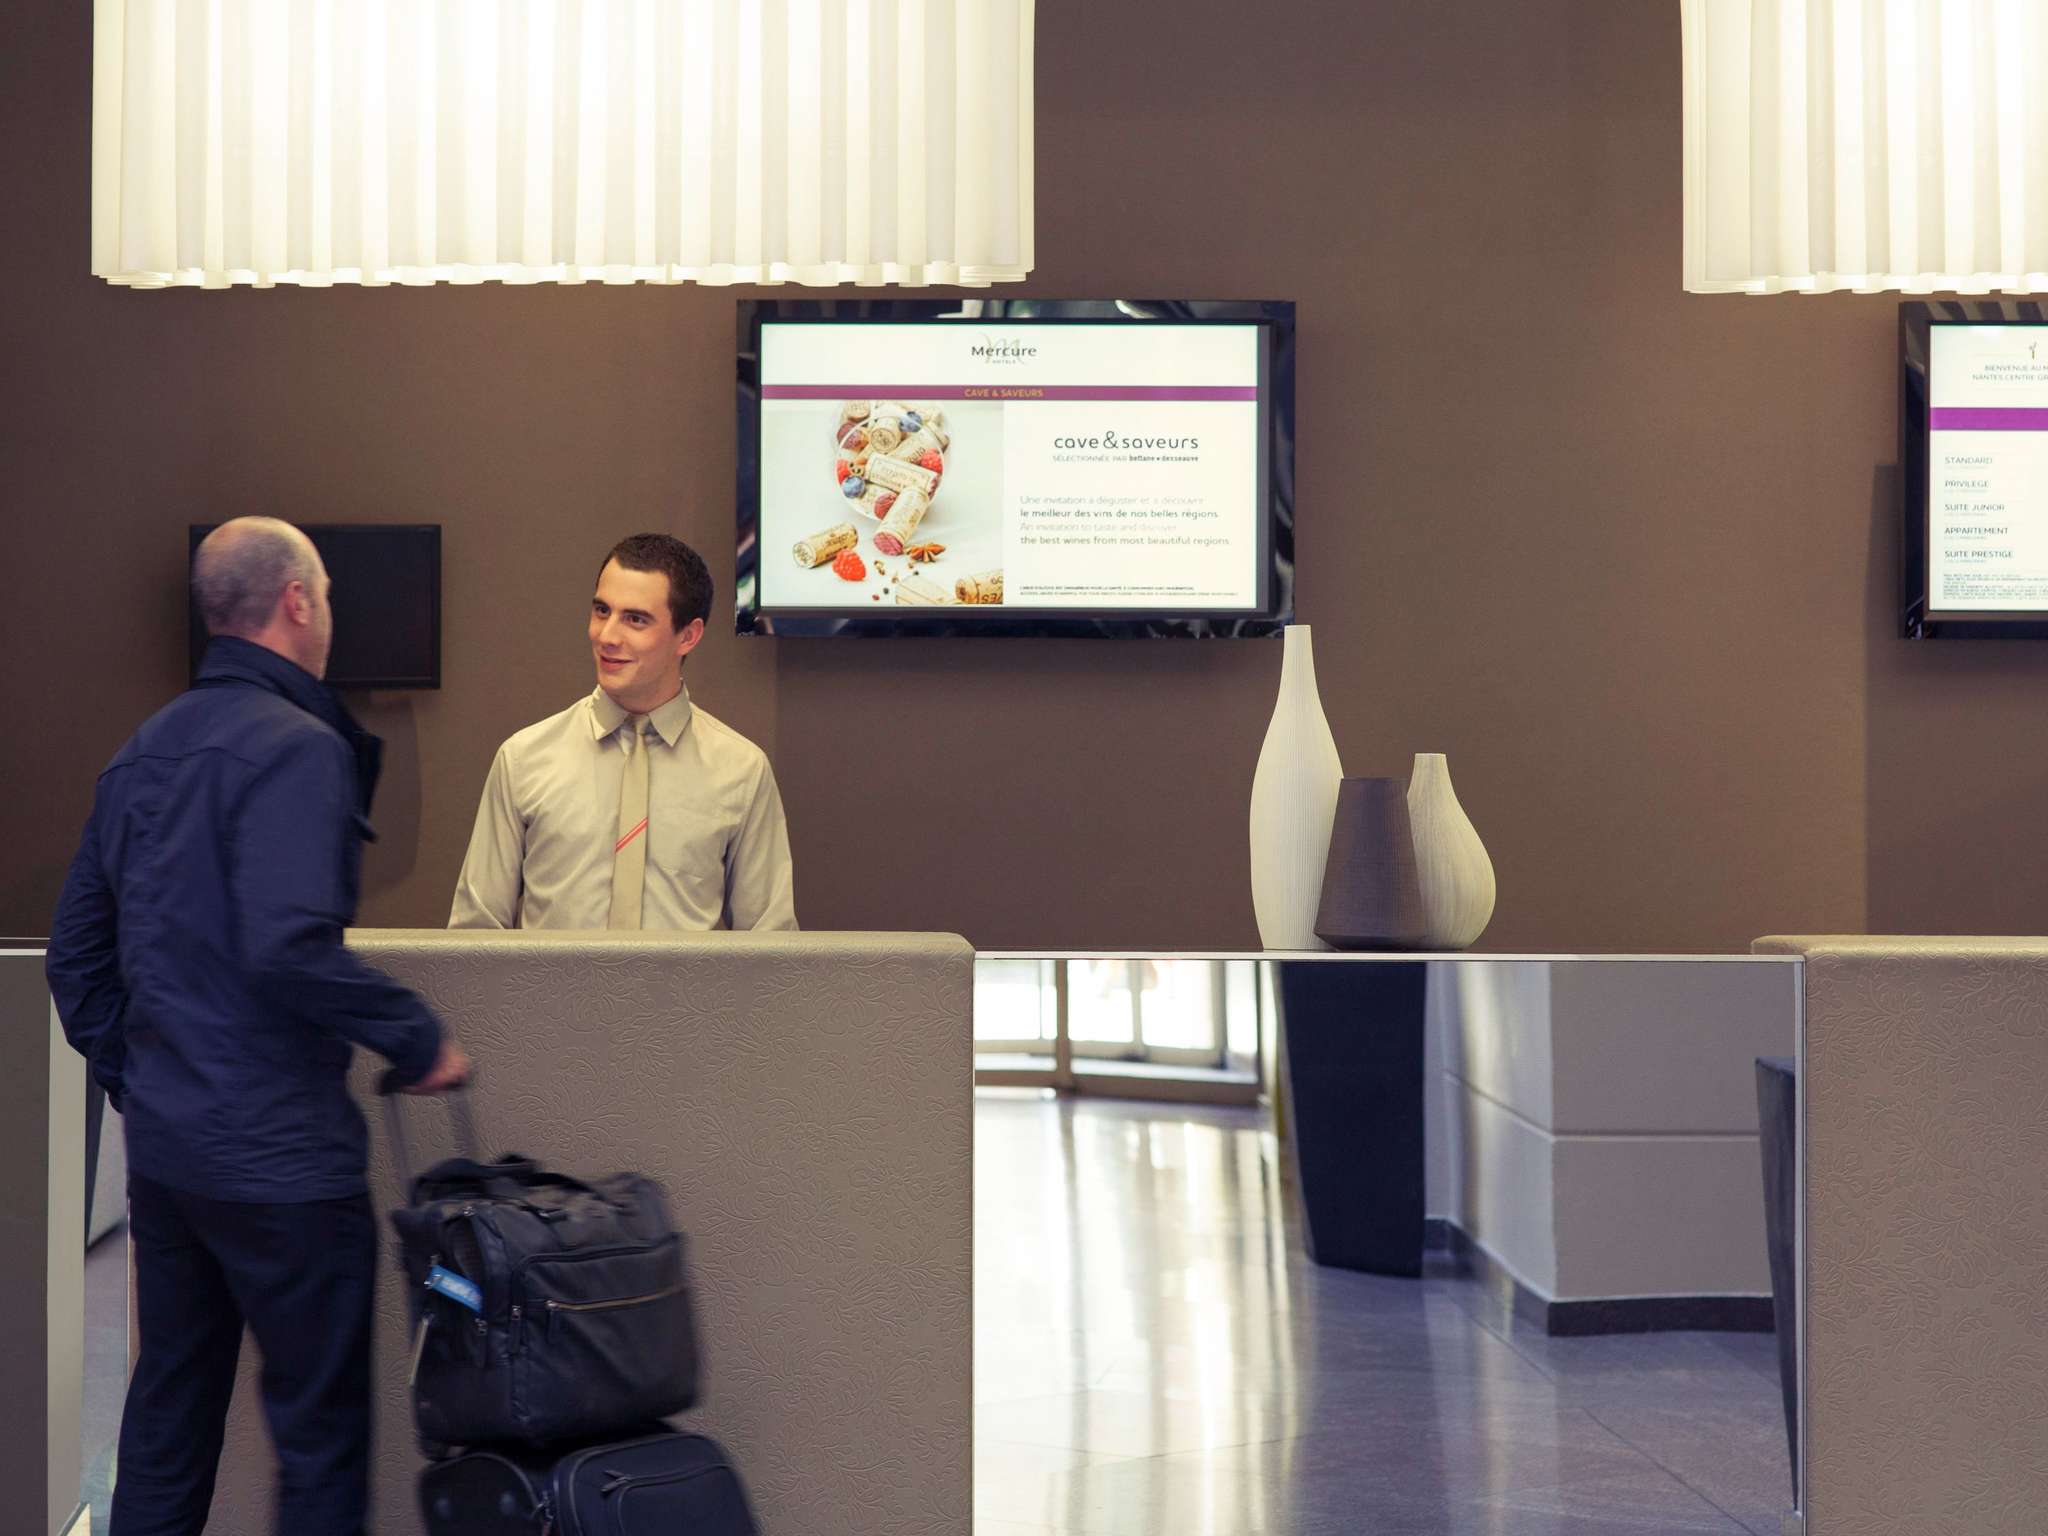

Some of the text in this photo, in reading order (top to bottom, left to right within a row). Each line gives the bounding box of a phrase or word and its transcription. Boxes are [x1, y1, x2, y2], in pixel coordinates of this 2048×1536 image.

[971, 345, 1037, 357] Mercure
[1984, 364, 2028, 372] BIENVENUE
[2031, 364, 2042, 372] AU
[1972, 373, 2004, 381] NANTES
[2005, 373, 2034, 381] CENTRE
[965, 388, 1043, 397] CAVE & SAVEURS
[1944, 456, 1993, 465] STANDARD
[1020, 495, 1041, 505] Une
[1043, 495, 1087, 505] invitation
[1139, 495, 1150, 505] et
[1944, 503, 2005, 511] SUITE JUNIOR
[1020, 508, 1029, 518] le
[1031, 508, 1071, 518] meilleur
[1074, 508, 1091, 518] des
[1093, 508, 1113, 518] vins
[1115, 508, 1128, 518] de
[1130, 510, 1148, 518] nos
[1150, 508, 1178, 518] belles
[1020, 521, 1033, 531] An
[1035, 521, 1079, 531] invitation
[1081, 521, 1092, 531] to
[1094, 521, 1115, 531] taste
[1119, 521, 1136, 531] and
[1944, 527, 2009, 535] APPARTEMENT
[1020, 535, 1038, 545] the
[1039, 535, 1061, 545] best
[1063, 535, 1091, 545] wines
[1094, 535, 1118, 545] from
[1119, 535, 1145, 545] most
[1147, 535, 1191, 545] beautiful
[1944, 550, 2013, 559] SUITE PRESTIGE
